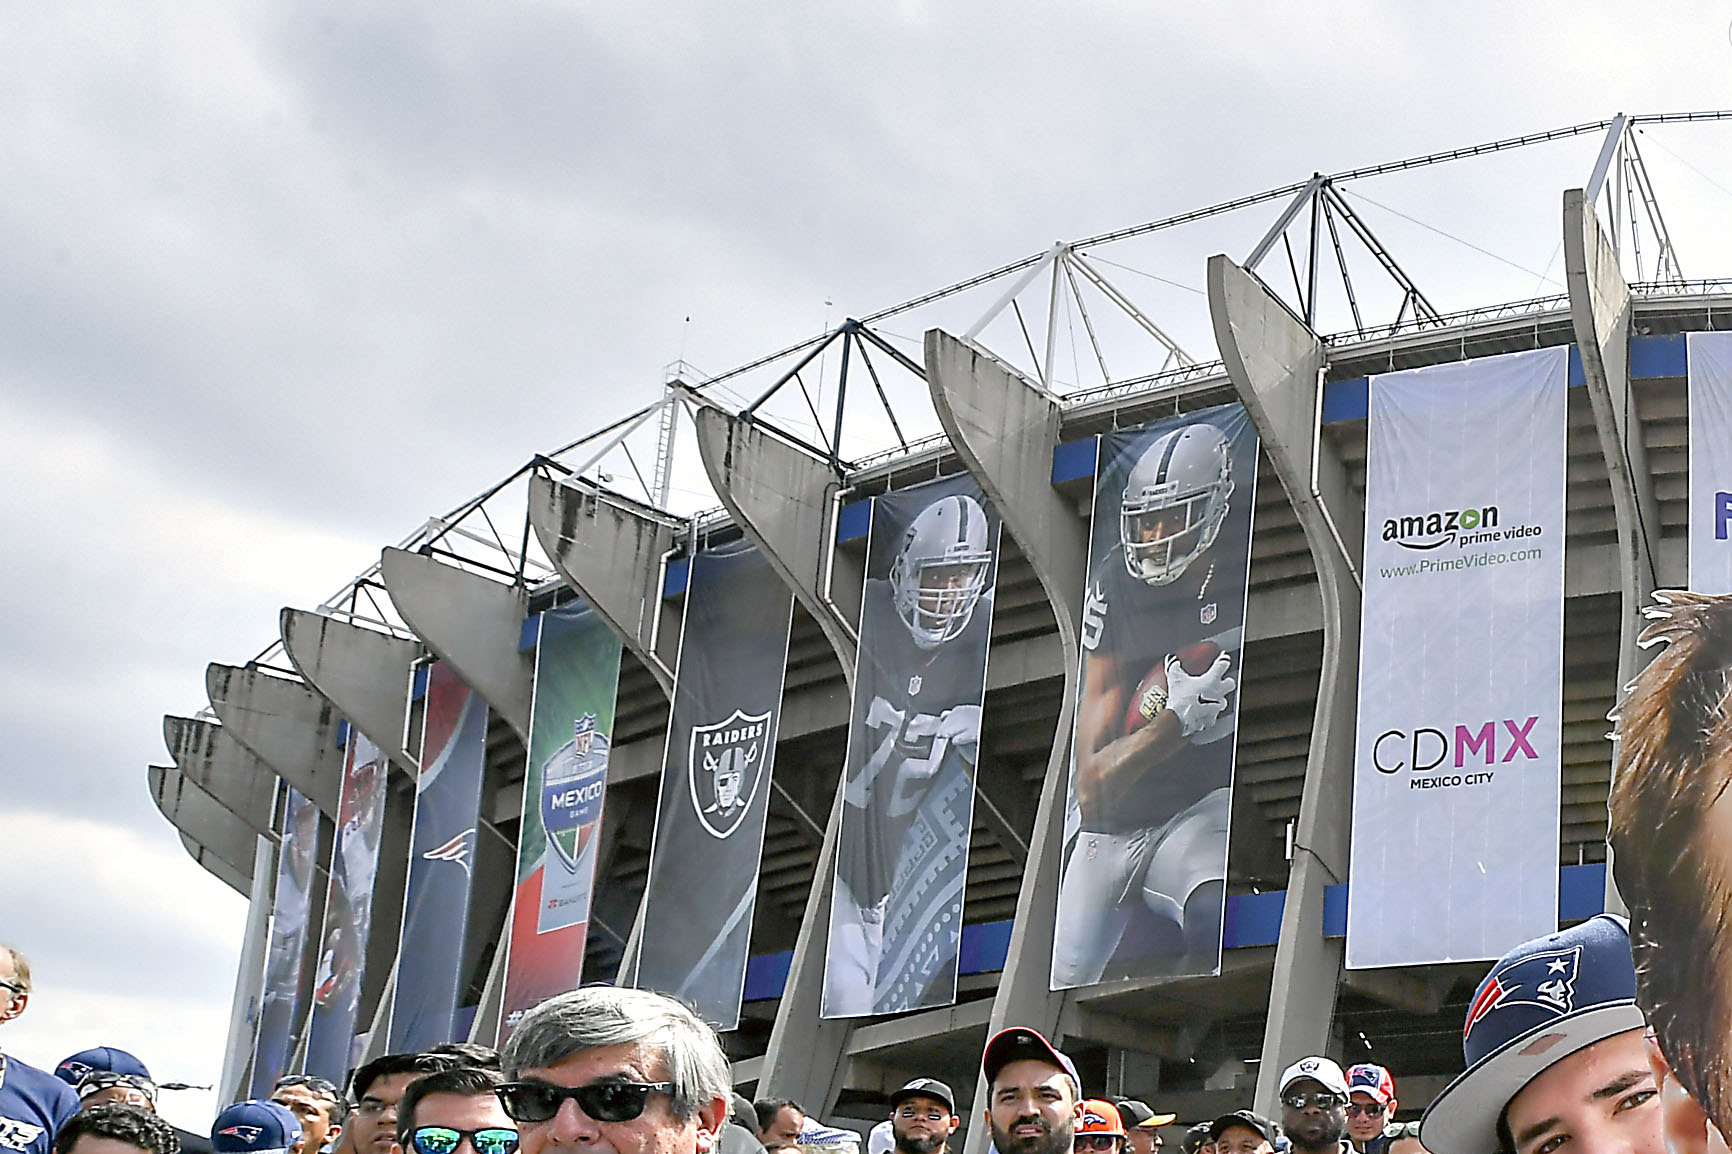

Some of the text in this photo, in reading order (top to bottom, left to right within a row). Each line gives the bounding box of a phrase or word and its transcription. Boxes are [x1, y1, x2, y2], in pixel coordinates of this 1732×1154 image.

[1382, 506, 1498, 541] amazon
[1460, 525, 1542, 548] prime video
[1380, 548, 1542, 579] www.PrimeVideo.com
[703, 723, 763, 747] RAIDERS
[1373, 716, 1539, 774] CDMX
[845, 696, 949, 818] 72
[551, 780, 603, 810] MEXICO
[1410, 772, 1494, 790] MEXICO CITY
